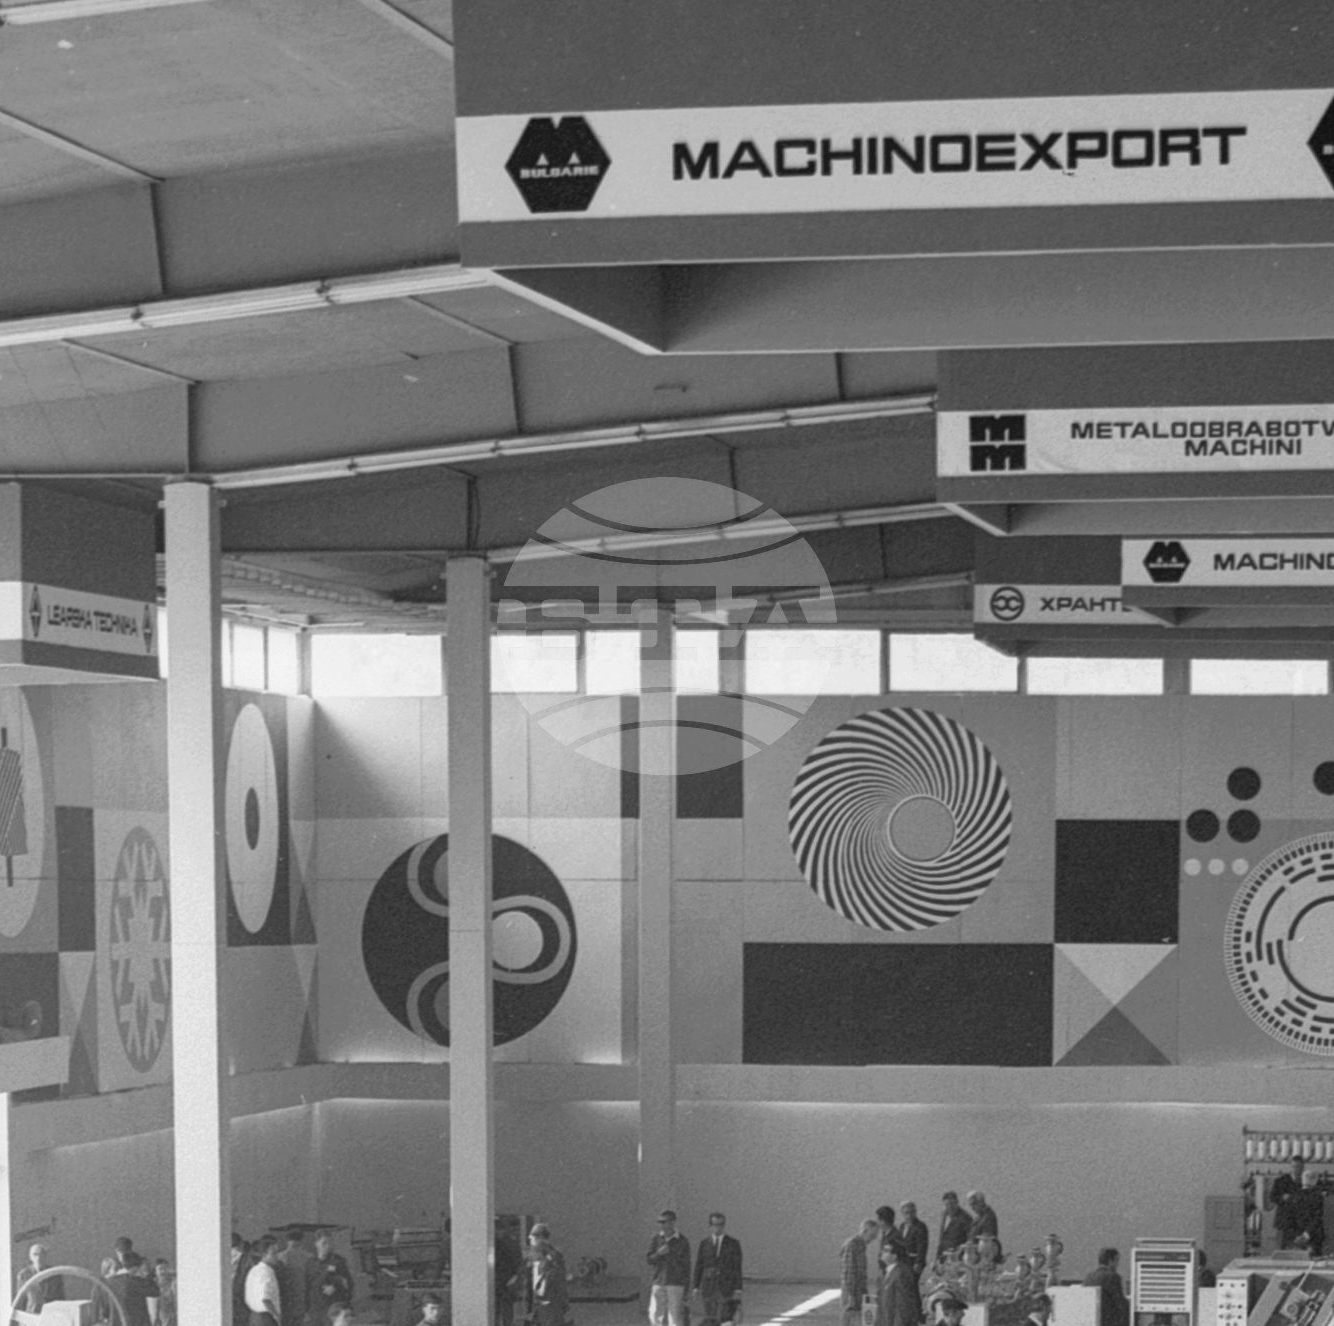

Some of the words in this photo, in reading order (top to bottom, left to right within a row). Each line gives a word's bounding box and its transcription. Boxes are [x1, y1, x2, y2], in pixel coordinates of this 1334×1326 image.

[672, 126, 1247, 181] MACHINOEXPORT
[519, 163, 600, 181] BULGARIE
[1184, 438, 1302, 457] MACHINI
[1040, 597, 1133, 612] ХРАНТ
